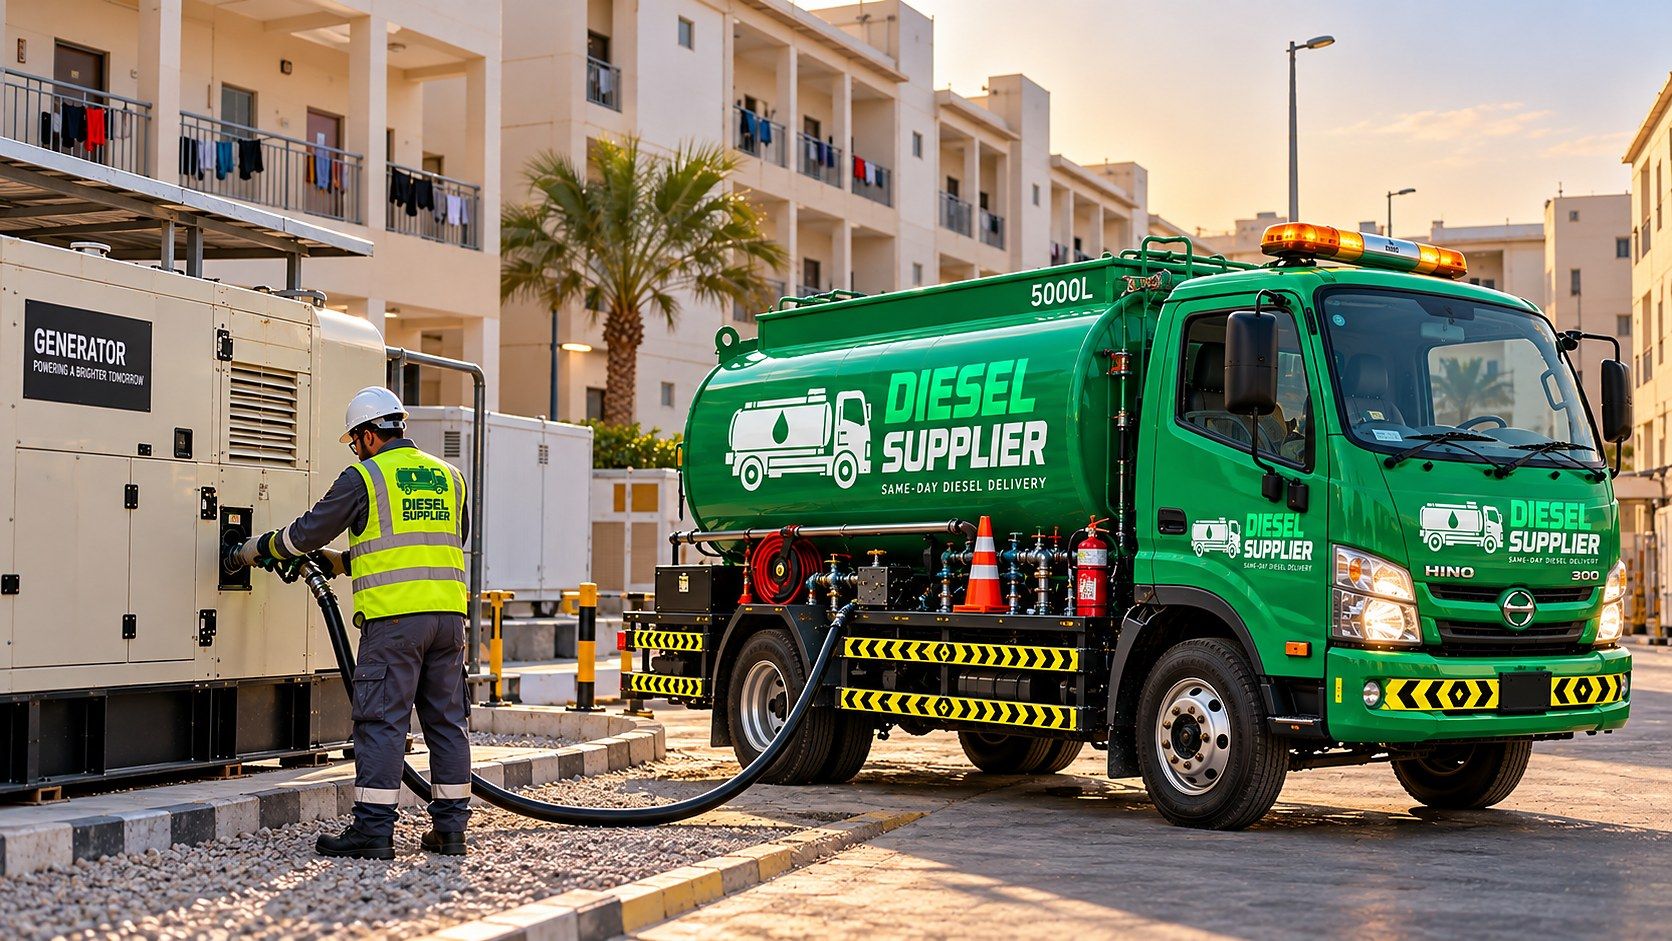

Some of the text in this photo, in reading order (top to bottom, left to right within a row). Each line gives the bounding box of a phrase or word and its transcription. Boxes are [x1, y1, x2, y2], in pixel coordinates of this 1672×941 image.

[1031, 277, 1093, 307] 5000L
[34, 327, 126, 366] GENERATOR
[33, 360, 68, 375] POWERING
[69, 365, 75, 377] A
[76, 366, 107, 381] BRIGHTER
[884, 358, 1036, 424] DIESEL
[881, 420, 1048, 473] SUPPLIER
[881, 476, 1047, 495] SAME-DAY DIESEL DELIVERY
[402, 499, 449, 511] DIESEL
[402, 510, 451, 521] SUPPLIER
[1510, 499, 1592, 530] DIESEL
[1245, 512, 1304, 538] DIESEL
[1243, 539, 1313, 561] SUPPLIER
[1508, 530, 1600, 555] SUPPLIER
[1425, 565, 1475, 578] HINO
[1571, 570, 1600, 581] 300
